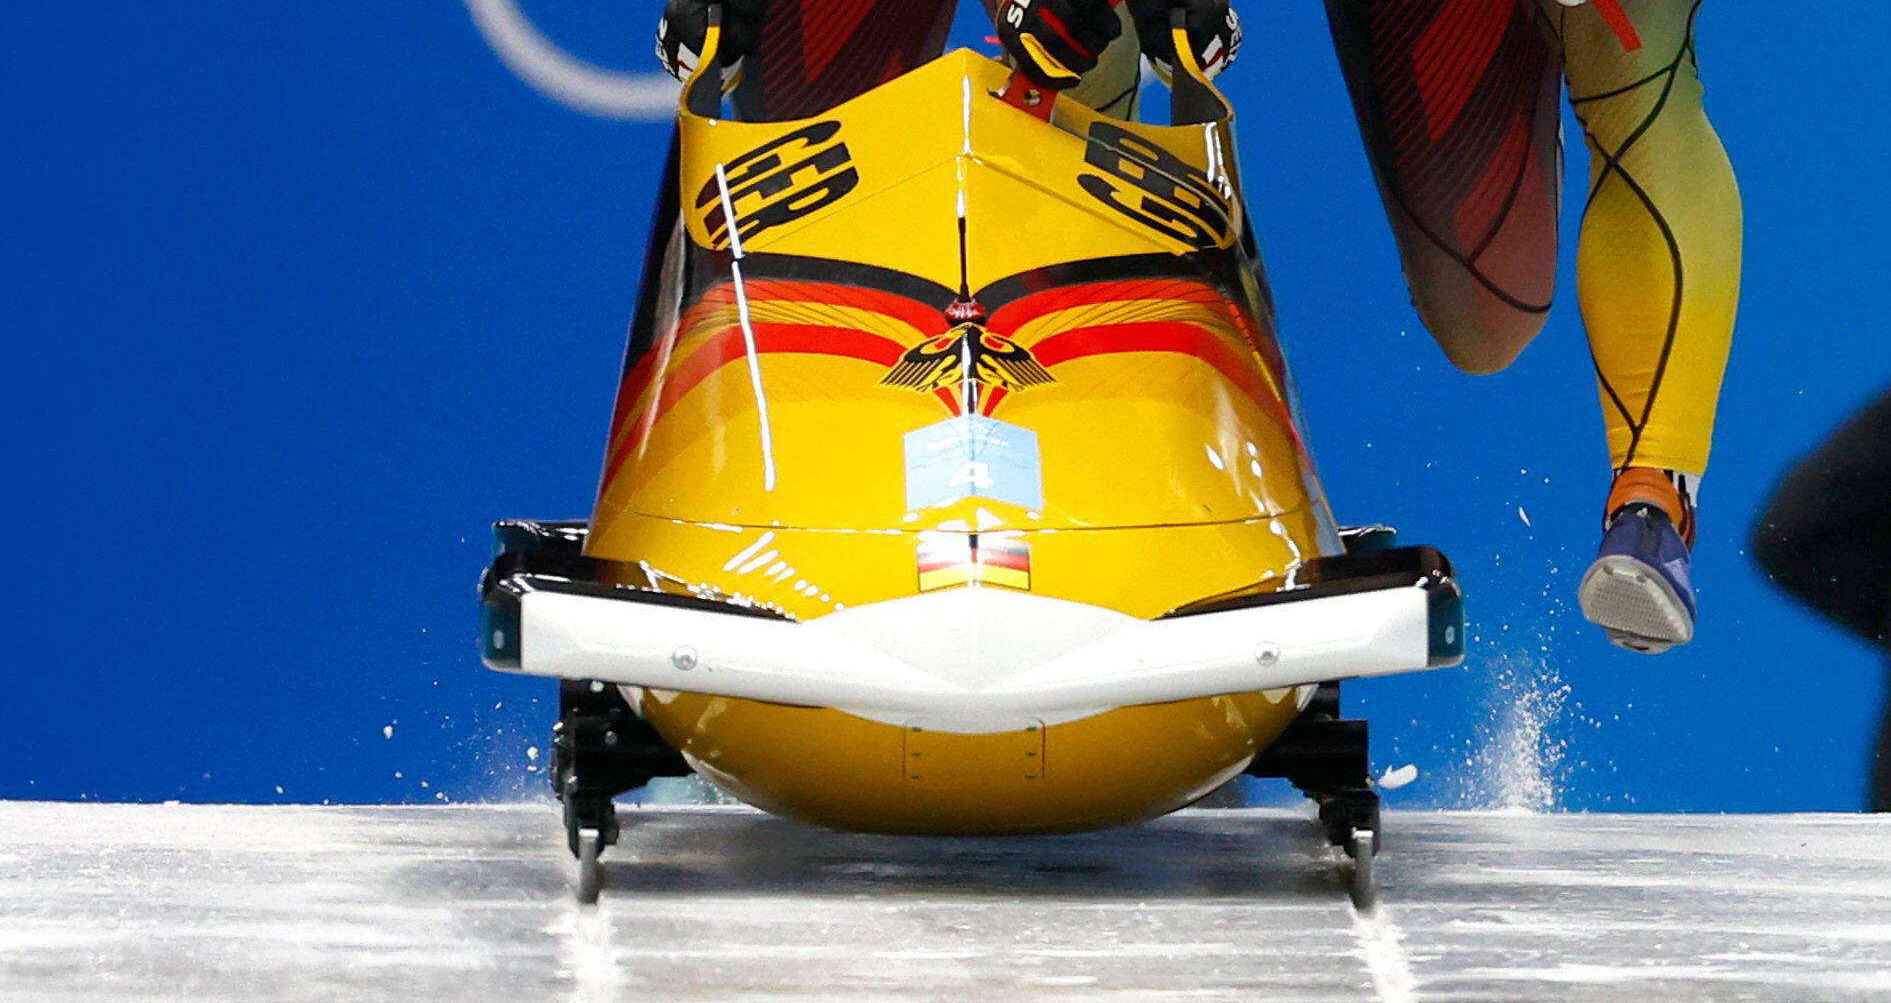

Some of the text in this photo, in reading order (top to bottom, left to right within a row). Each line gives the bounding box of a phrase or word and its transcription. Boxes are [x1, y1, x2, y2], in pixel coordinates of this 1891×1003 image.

[695, 120, 860, 251] GER
[1077, 121, 1231, 250] GER
[947, 461, 995, 490] 4
